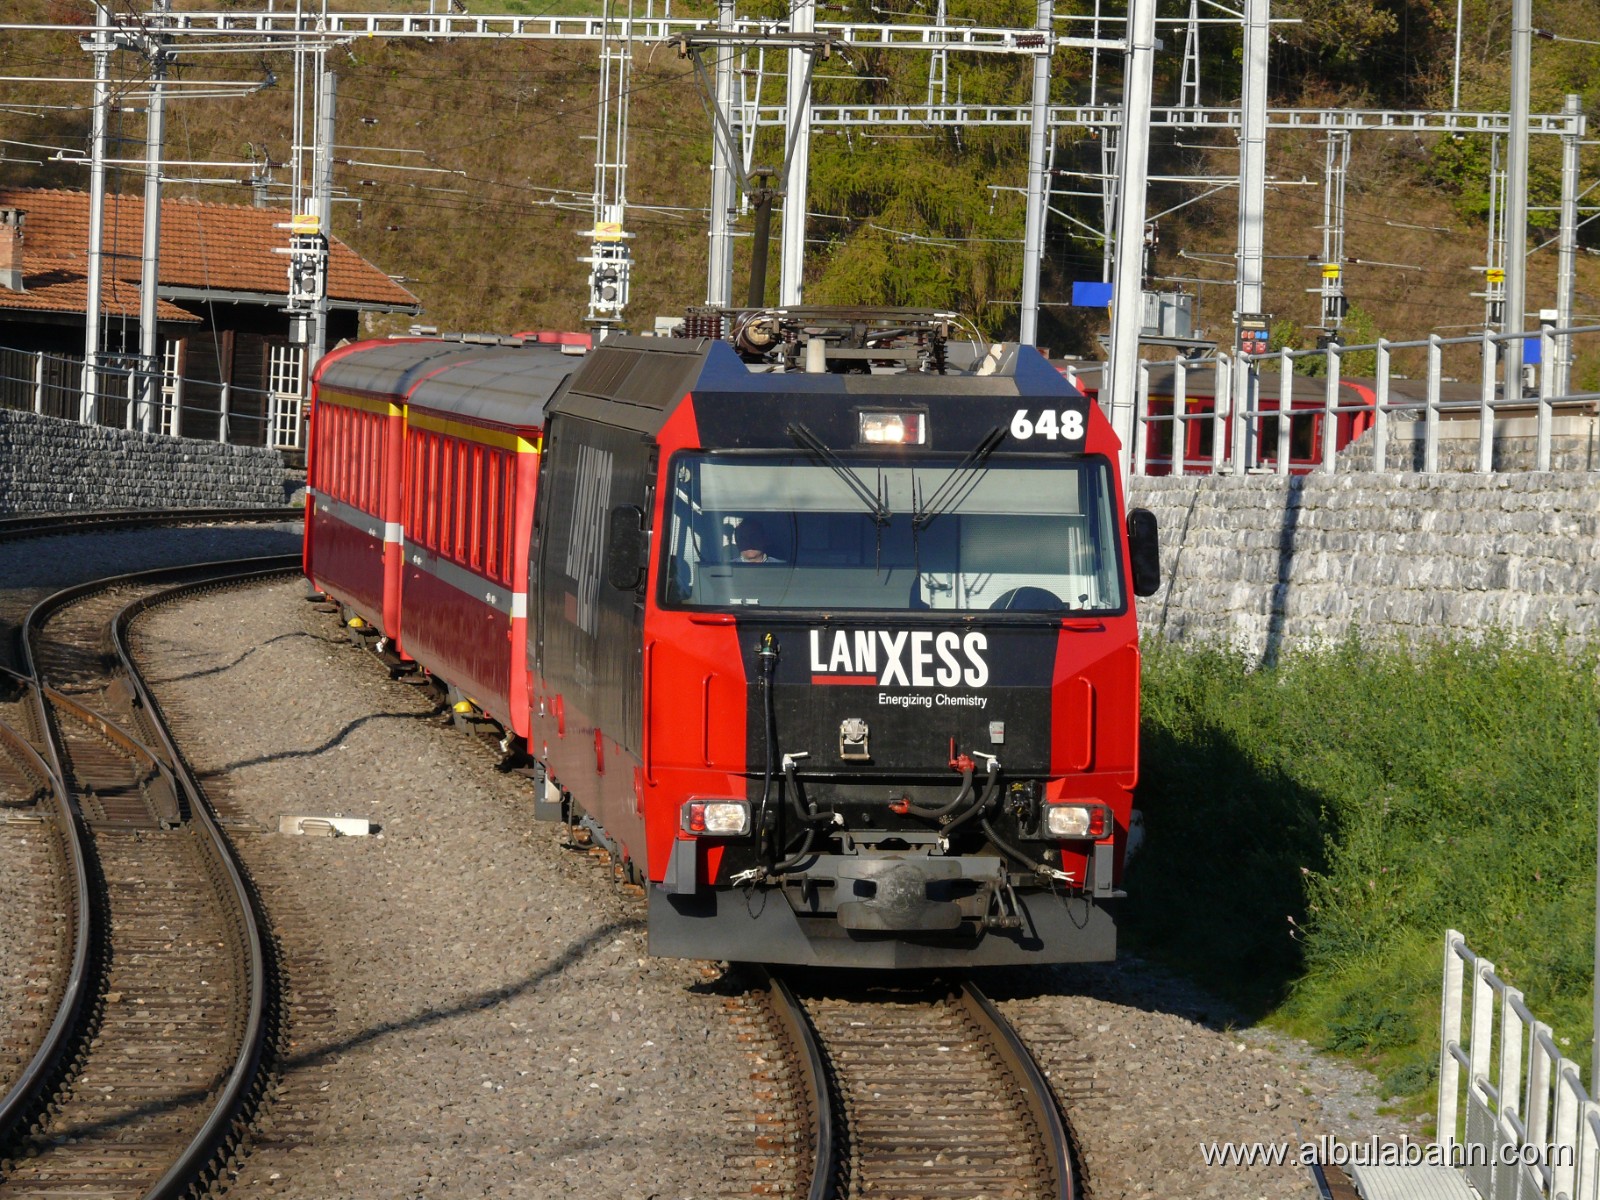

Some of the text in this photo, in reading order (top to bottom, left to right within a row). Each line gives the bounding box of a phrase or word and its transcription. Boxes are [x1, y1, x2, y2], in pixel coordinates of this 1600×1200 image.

[1010, 409, 1084, 440] 648
[810, 630, 989, 688] LANXESS
[878, 693, 988, 709] Energizing Chemistry
